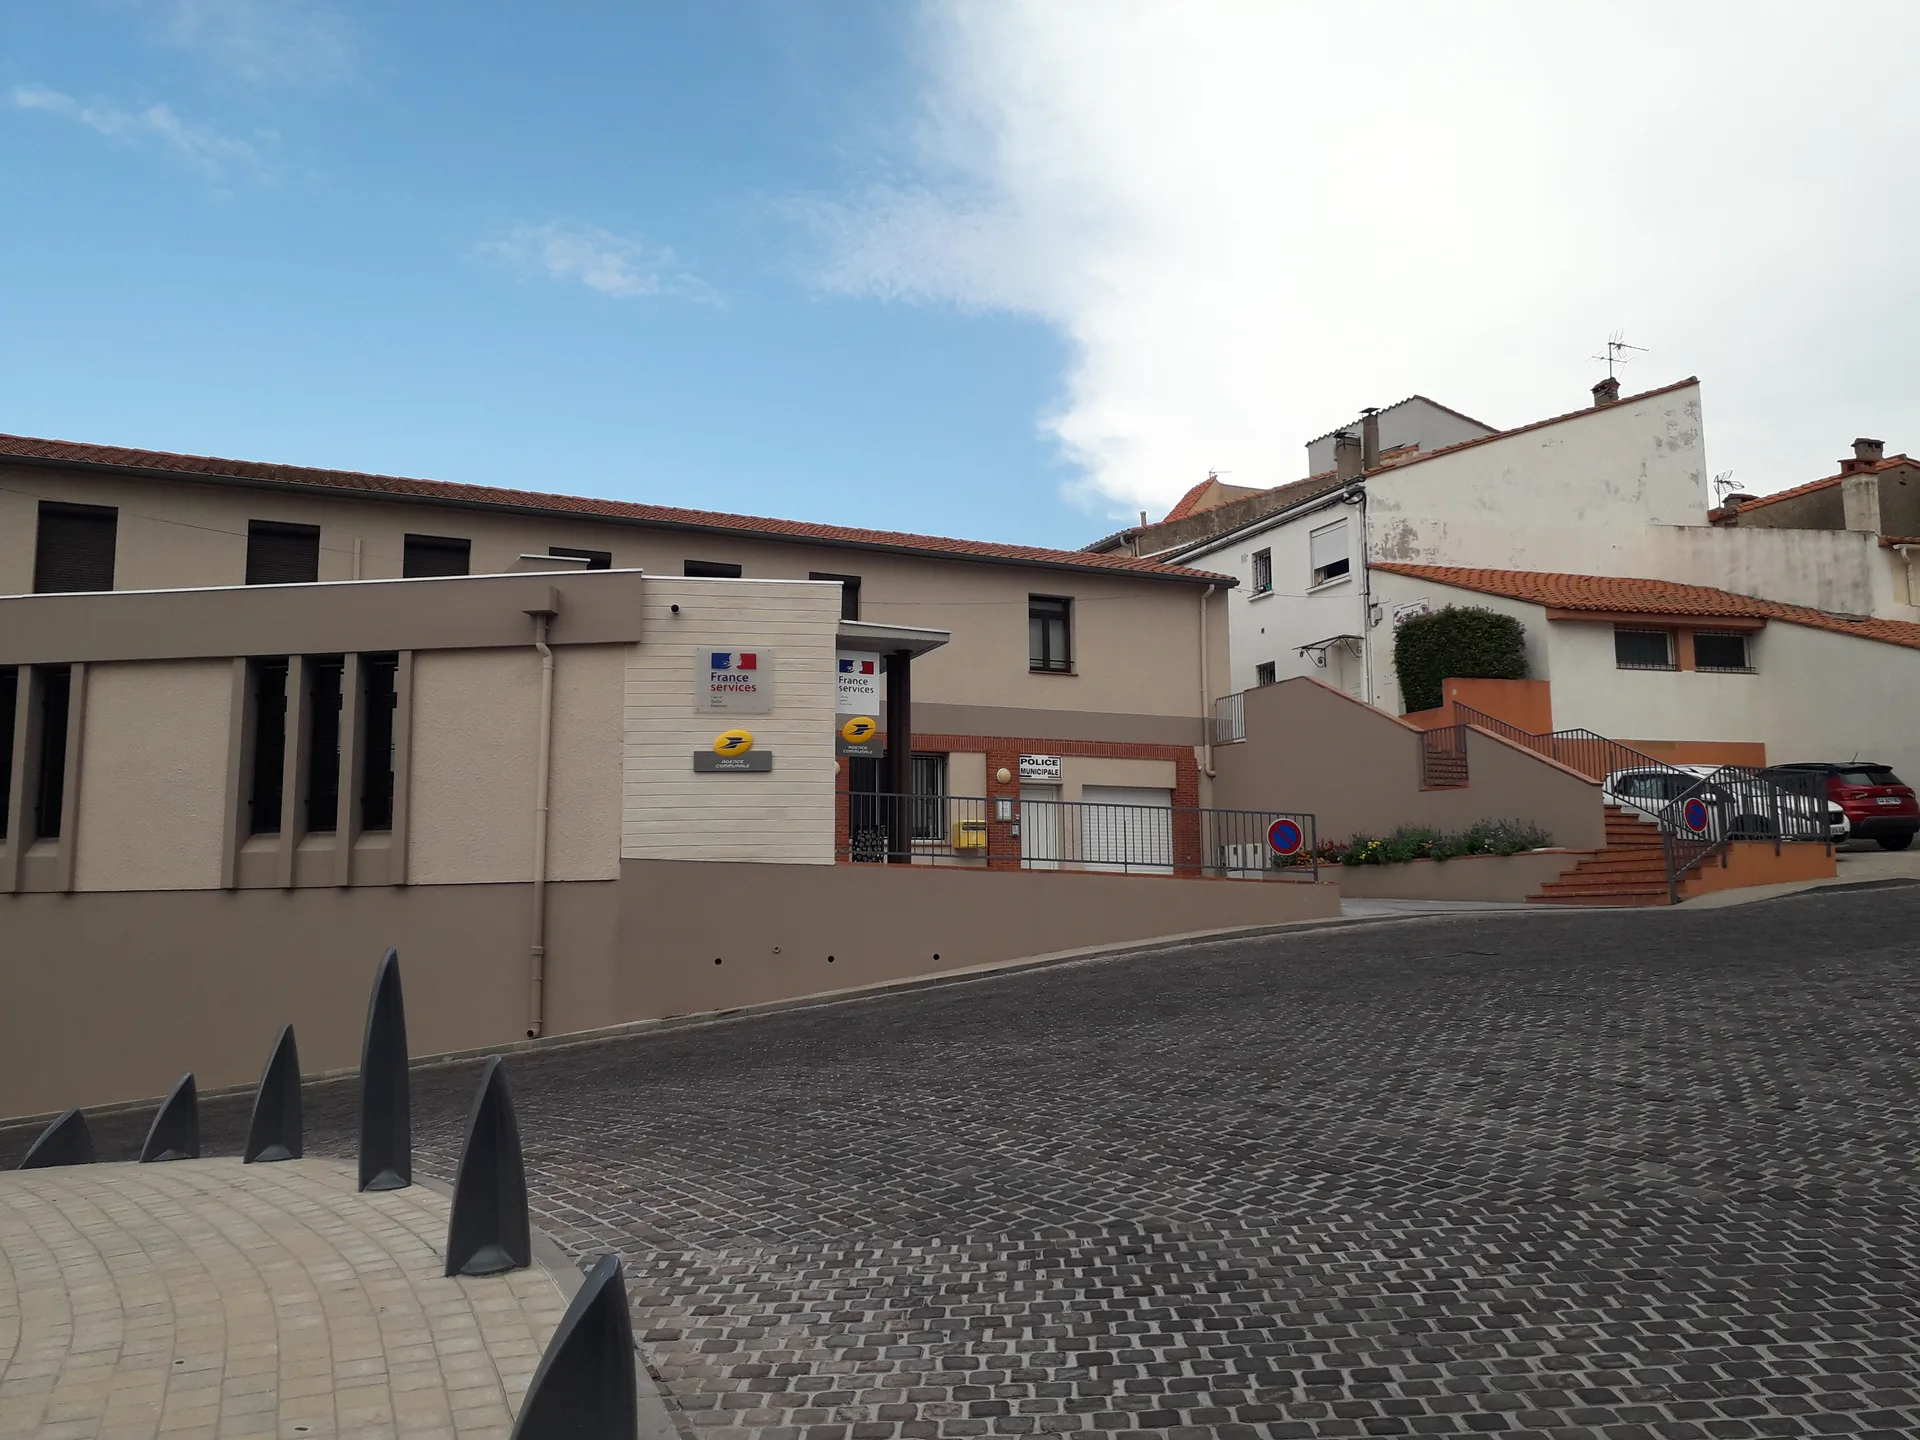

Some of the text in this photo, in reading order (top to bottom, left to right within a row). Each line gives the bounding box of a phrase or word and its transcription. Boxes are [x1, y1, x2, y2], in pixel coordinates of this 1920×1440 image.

[710, 671, 749, 682] France
[838, 675, 869, 686] France
[710, 682, 757, 692] services
[838, 684, 875, 694] services
[1020, 758, 1059, 766] POLICE
[1020, 767, 1059, 776] MUNICIPALE
